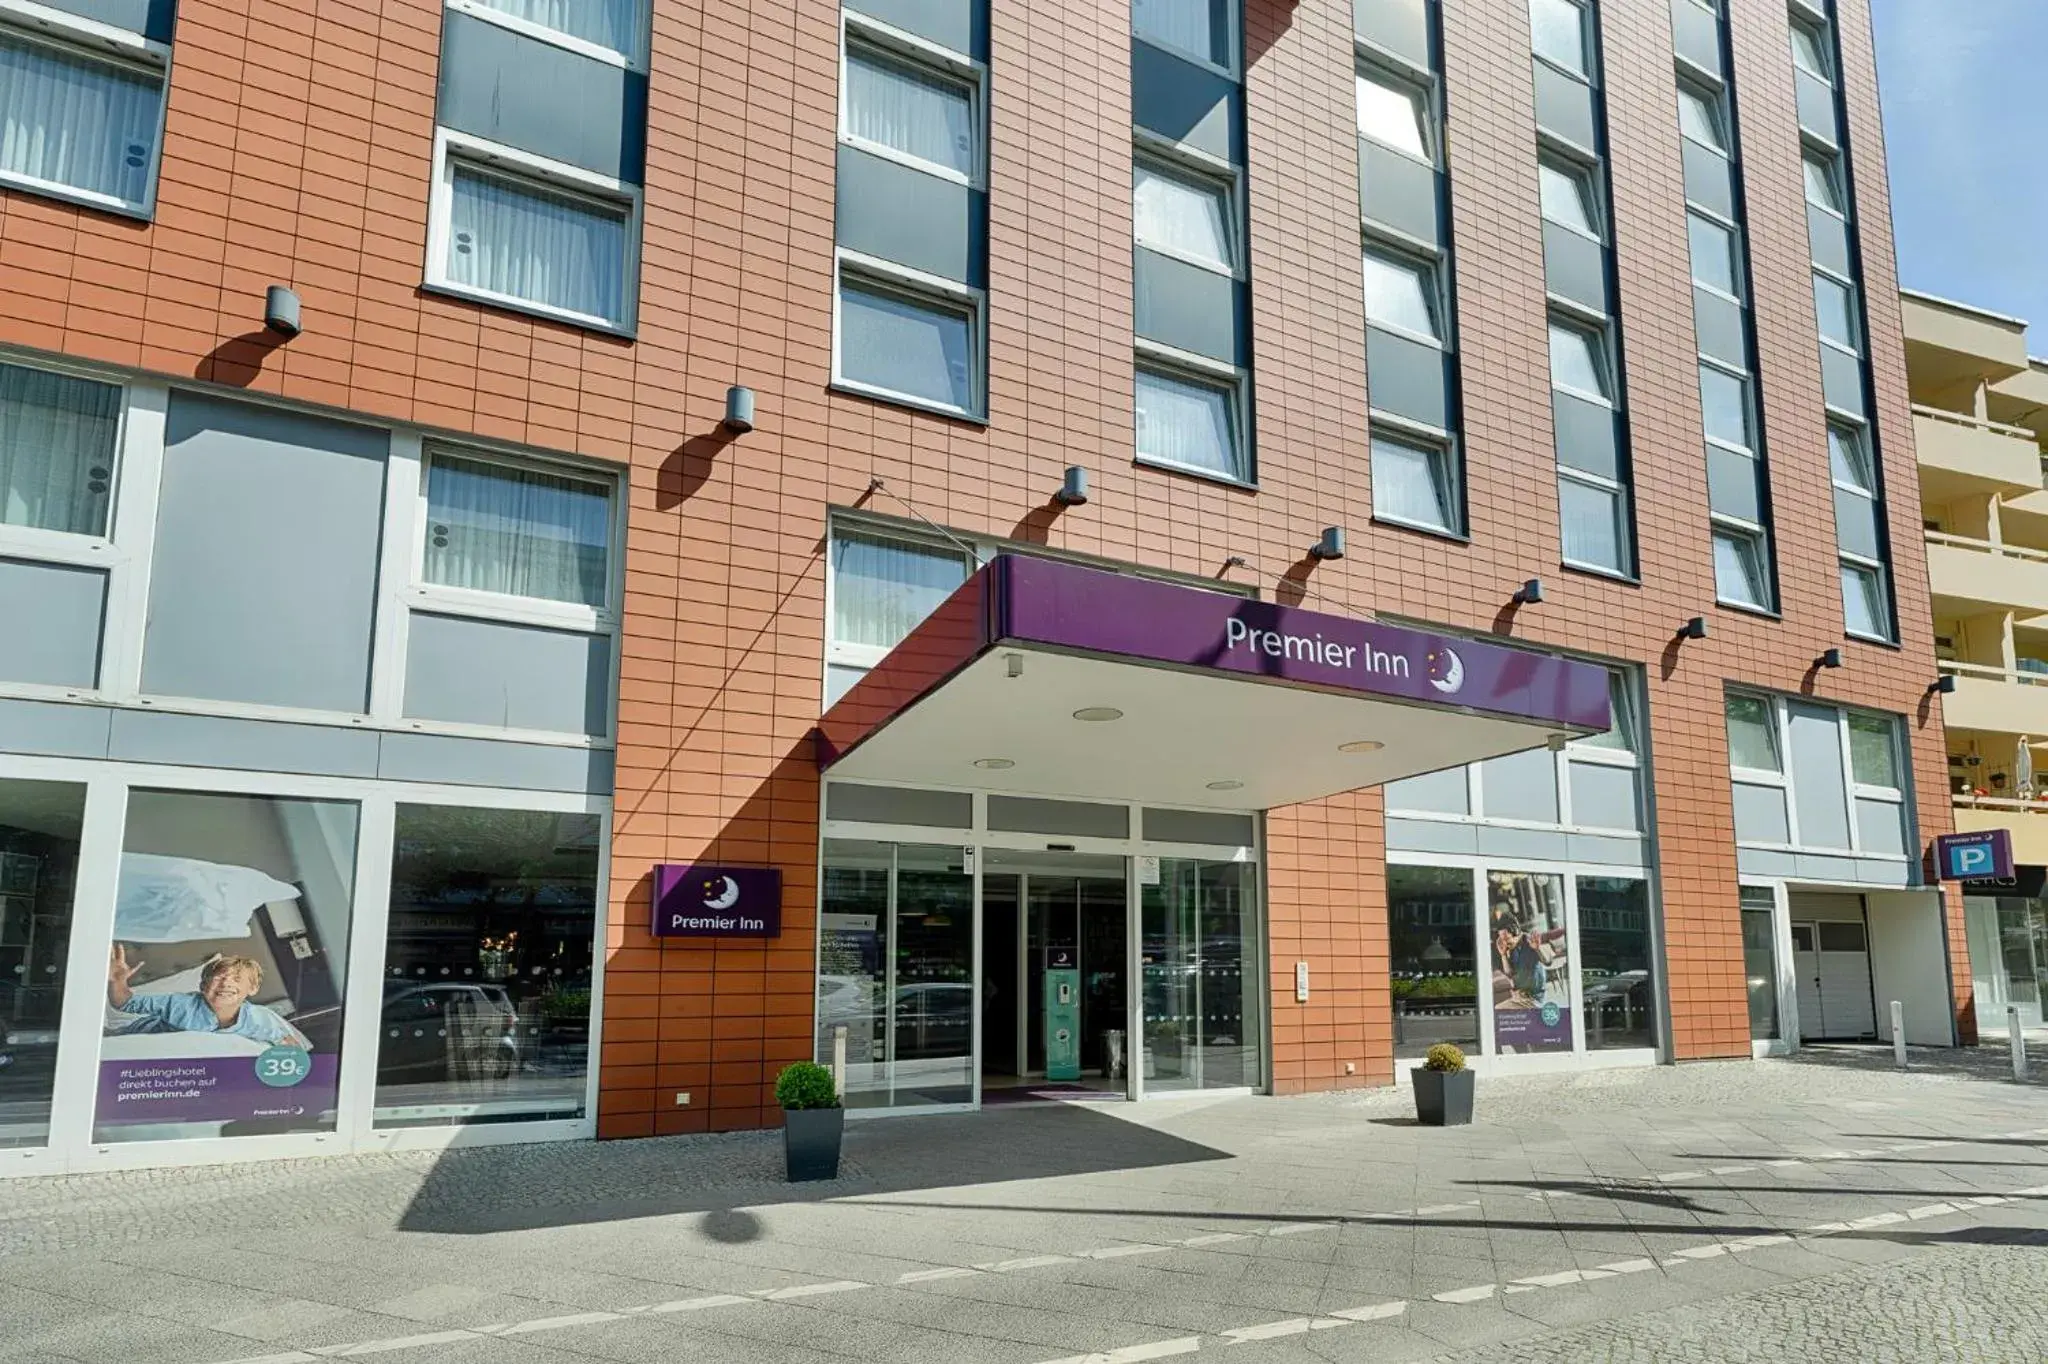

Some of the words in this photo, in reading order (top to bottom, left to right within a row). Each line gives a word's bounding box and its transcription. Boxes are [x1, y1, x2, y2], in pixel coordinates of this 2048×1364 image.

[1226, 617, 1356, 669] Premier
[1365, 642, 1410, 678] Inn
[1960, 848, 1986, 872] P
[672, 914, 737, 930] Premier
[740, 916, 764, 930] Inn
